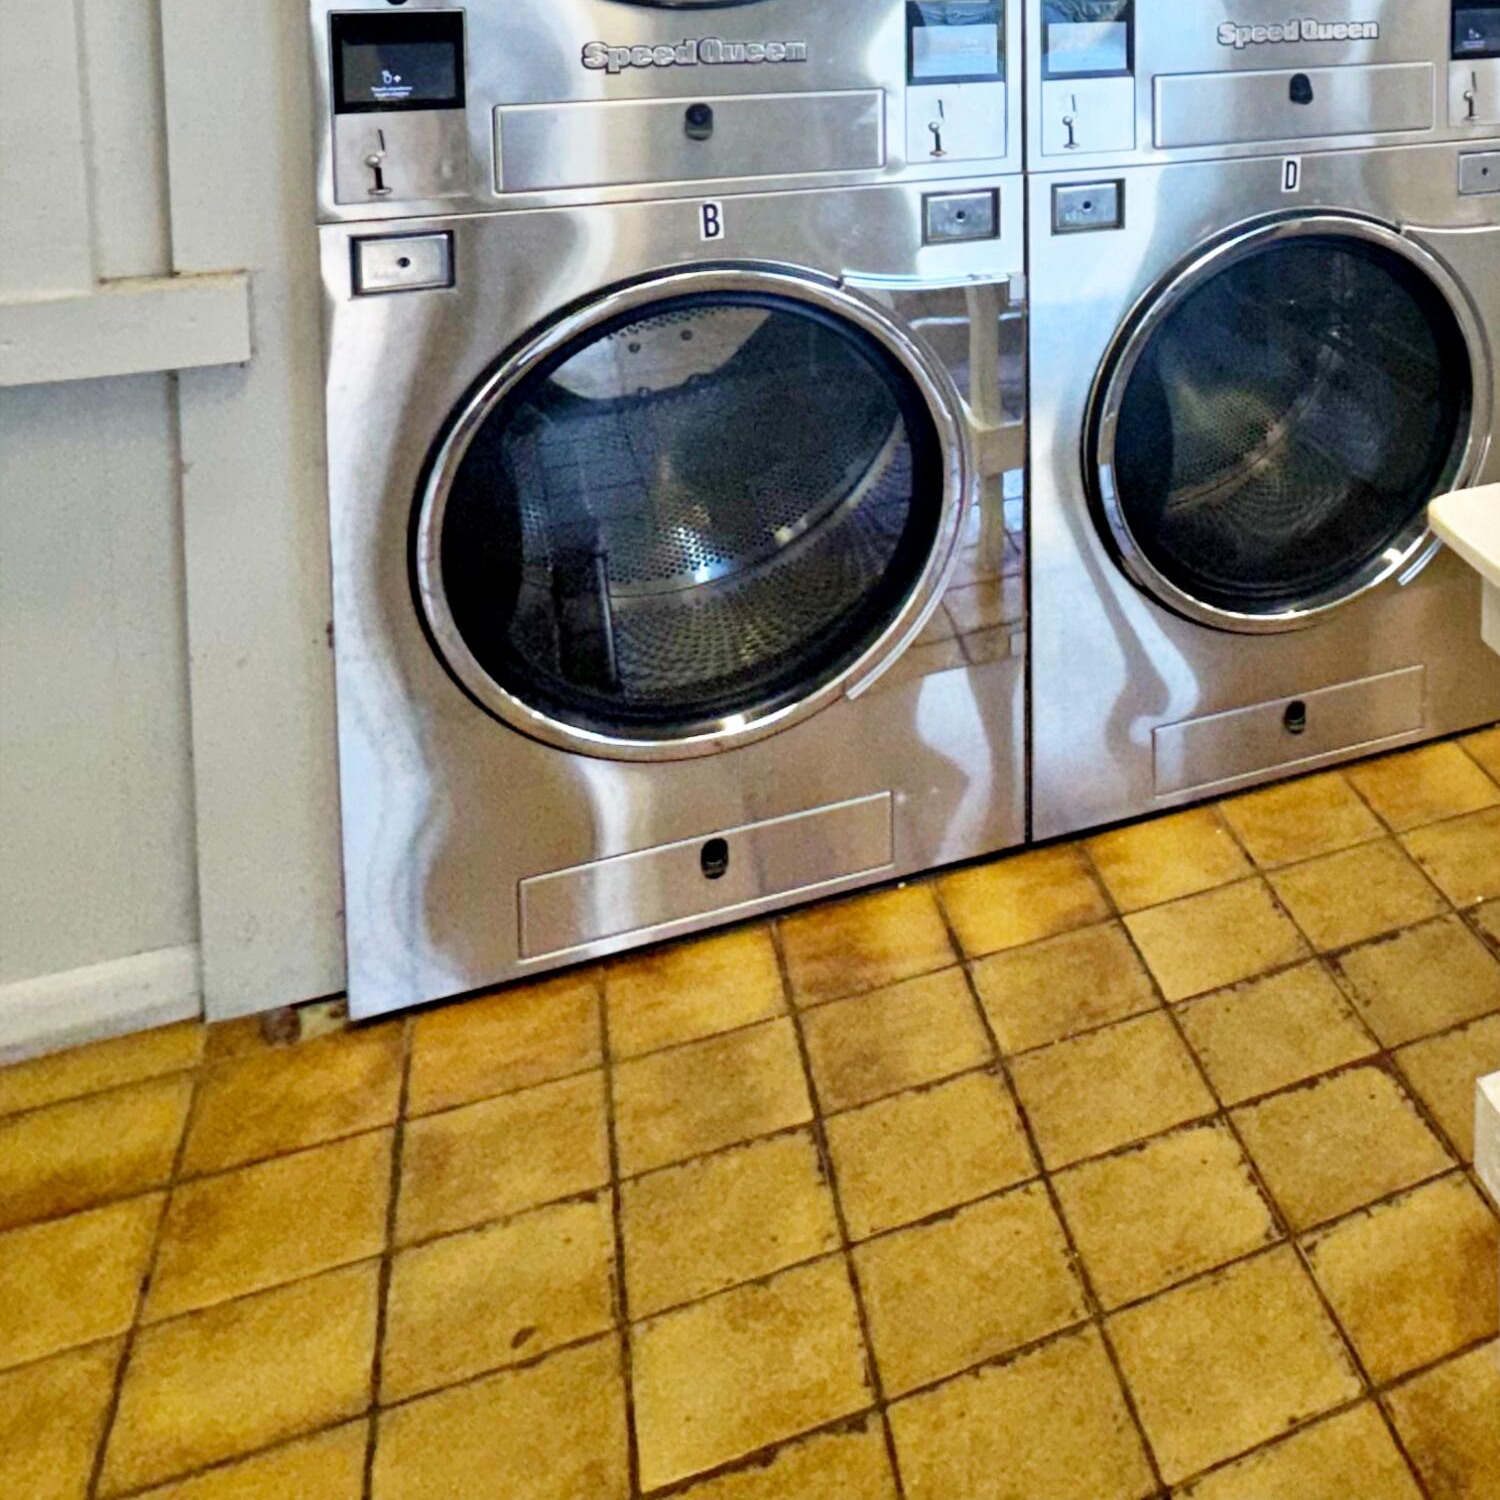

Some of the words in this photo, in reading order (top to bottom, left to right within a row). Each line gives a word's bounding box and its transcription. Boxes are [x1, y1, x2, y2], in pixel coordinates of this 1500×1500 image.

[1217, 20, 1300, 49] Speed
[1300, 18, 1379, 42] Queen
[582, 38, 698, 74] Speed
[699, 37, 808, 65] Queen
[1285, 160, 1298, 190] D
[703, 203, 720, 238] B
